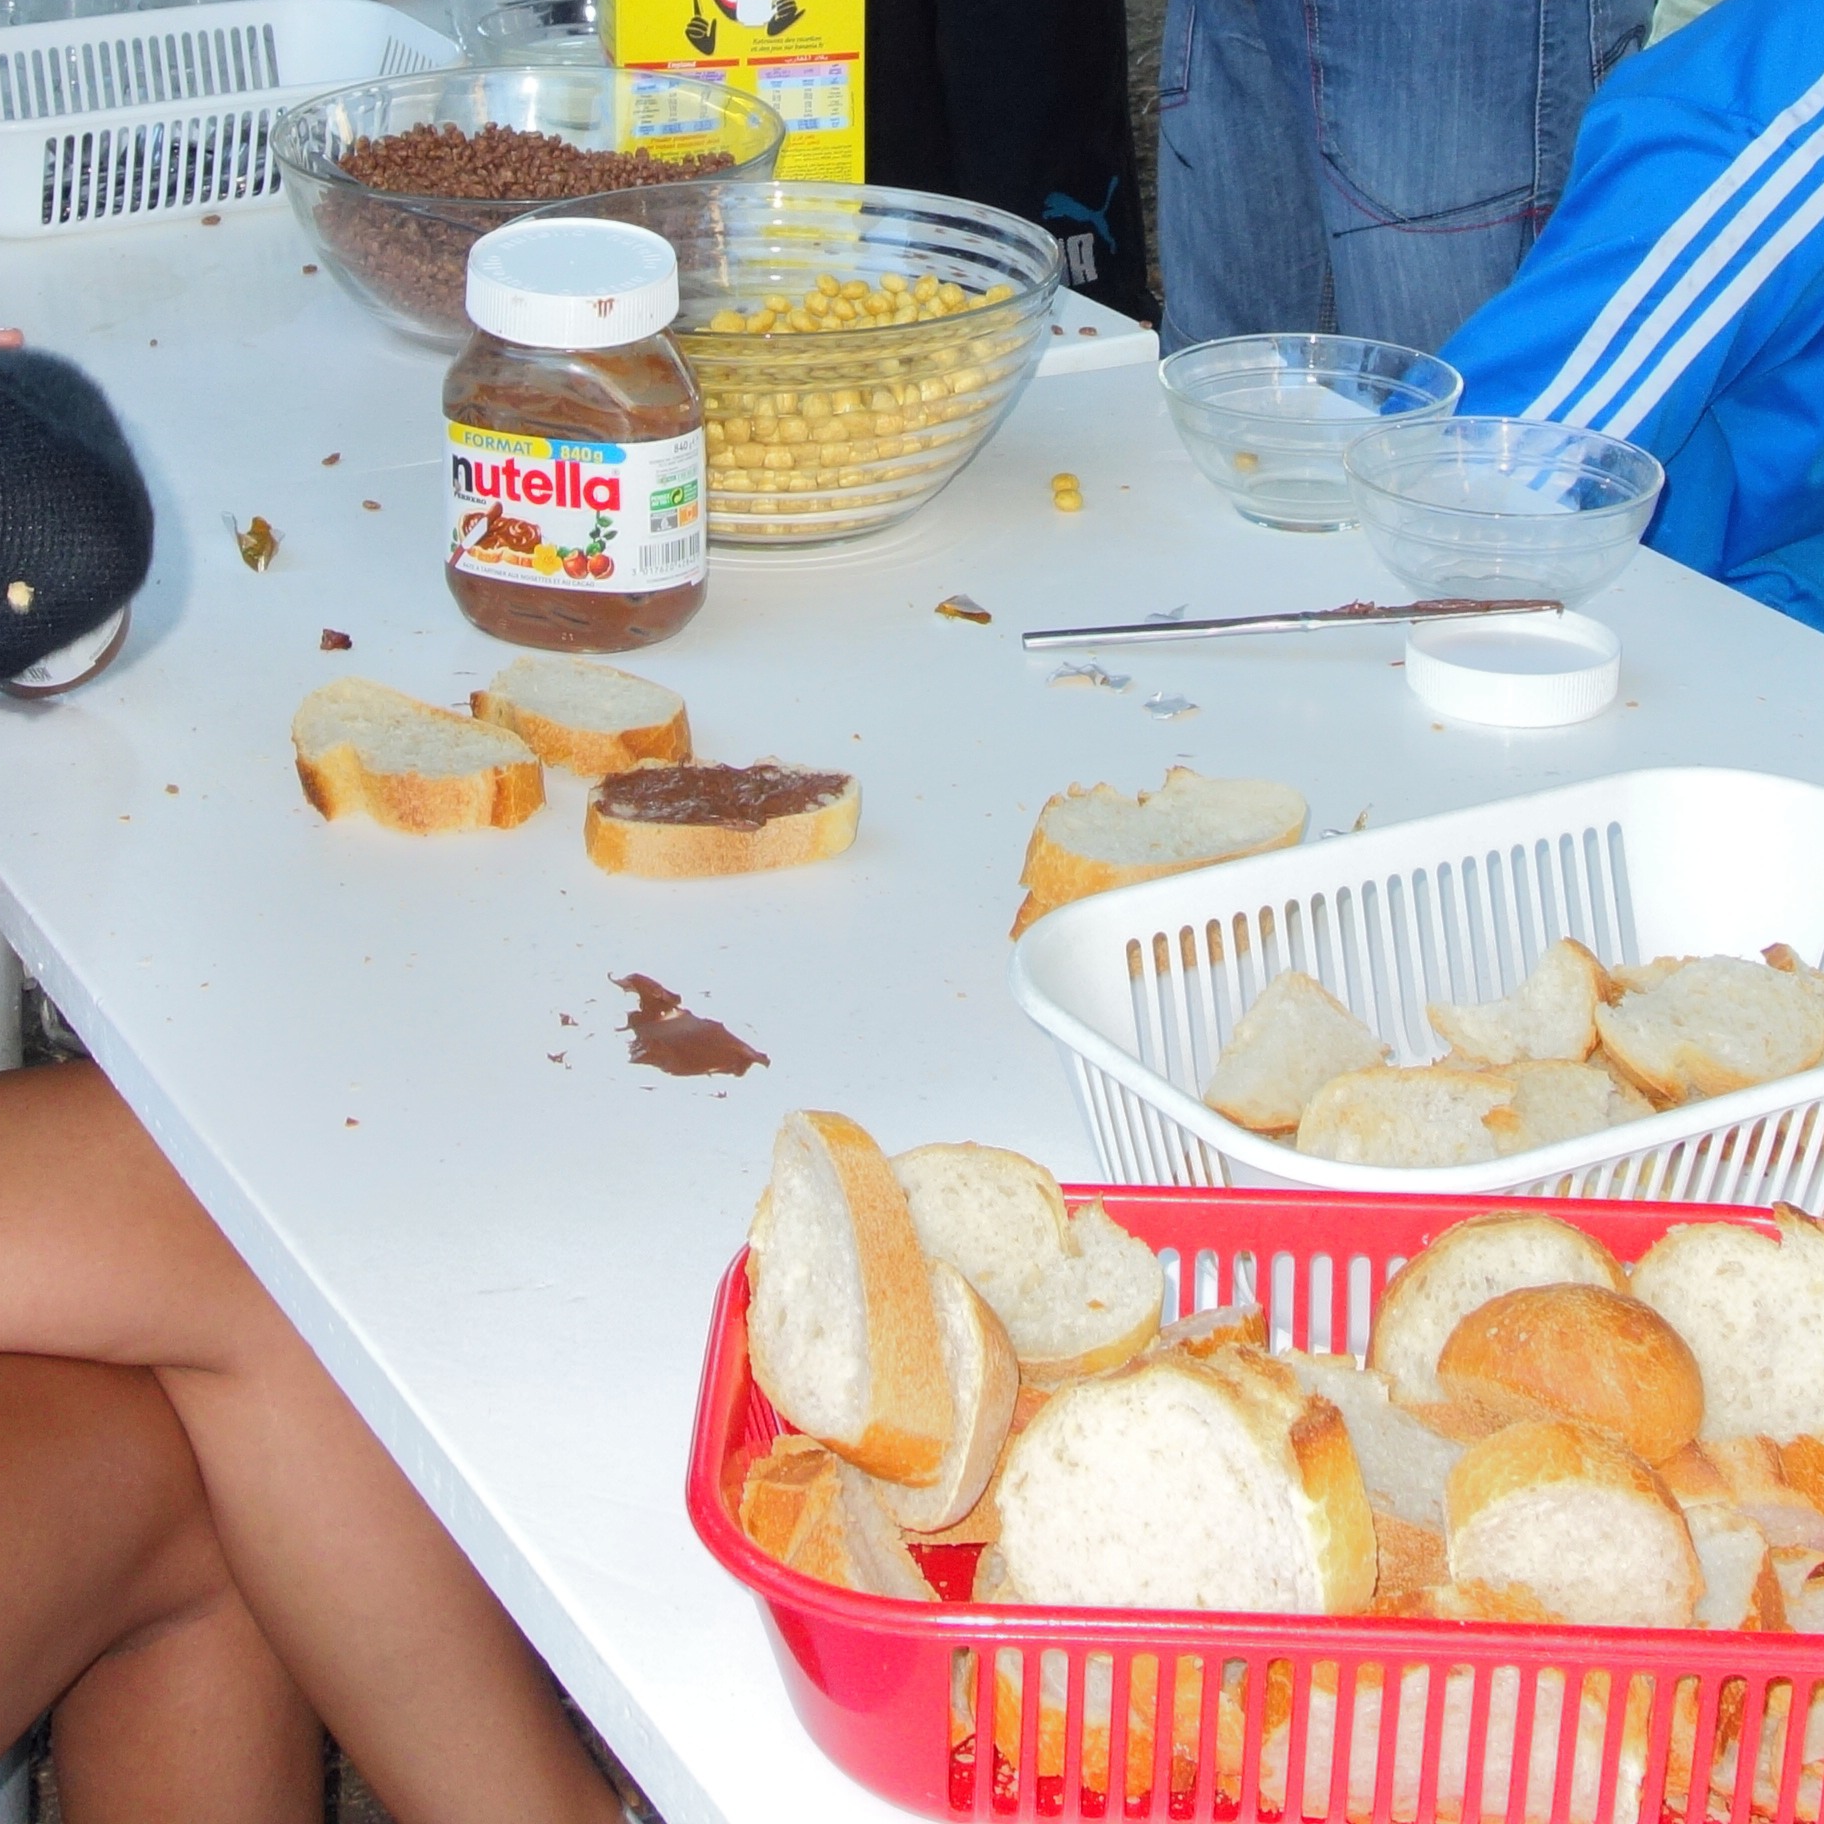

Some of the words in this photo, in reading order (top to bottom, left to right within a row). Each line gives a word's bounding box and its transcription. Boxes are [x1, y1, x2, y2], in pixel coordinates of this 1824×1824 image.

[465, 432, 533, 456] FORMAT
[560, 445, 604, 464] 840g
[452, 453, 621, 511] nutella
